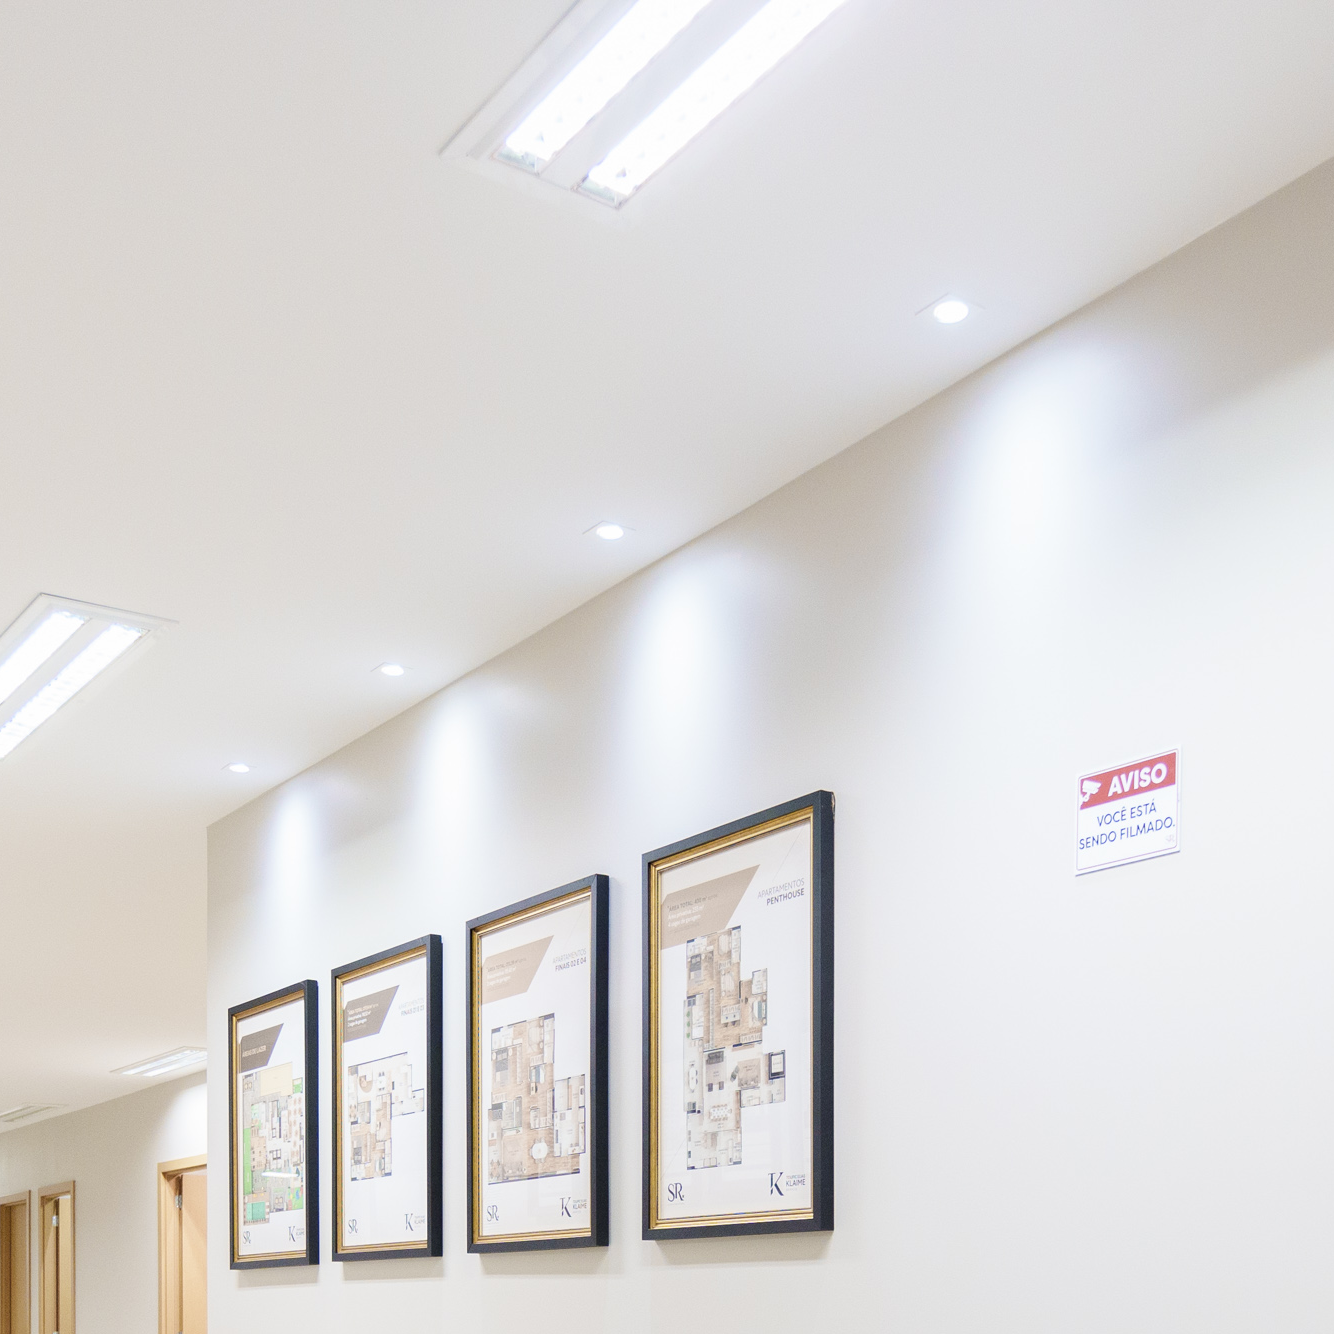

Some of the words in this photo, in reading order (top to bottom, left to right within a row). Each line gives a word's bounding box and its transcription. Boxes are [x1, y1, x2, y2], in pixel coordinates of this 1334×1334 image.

[1108, 762, 1168, 797] AVISO
[1097, 806, 1127, 827] VOCÊ
[1130, 798, 1157, 819] ESTÁ
[1079, 831, 1117, 850] SENDO
[1120, 816, 1176, 840] FILMADO.
[758, 878, 805, 899] APARTAMENTOS
[766, 888, 805, 906] PENTHOUSE
[785, 1178, 806, 1187] KLAIME
